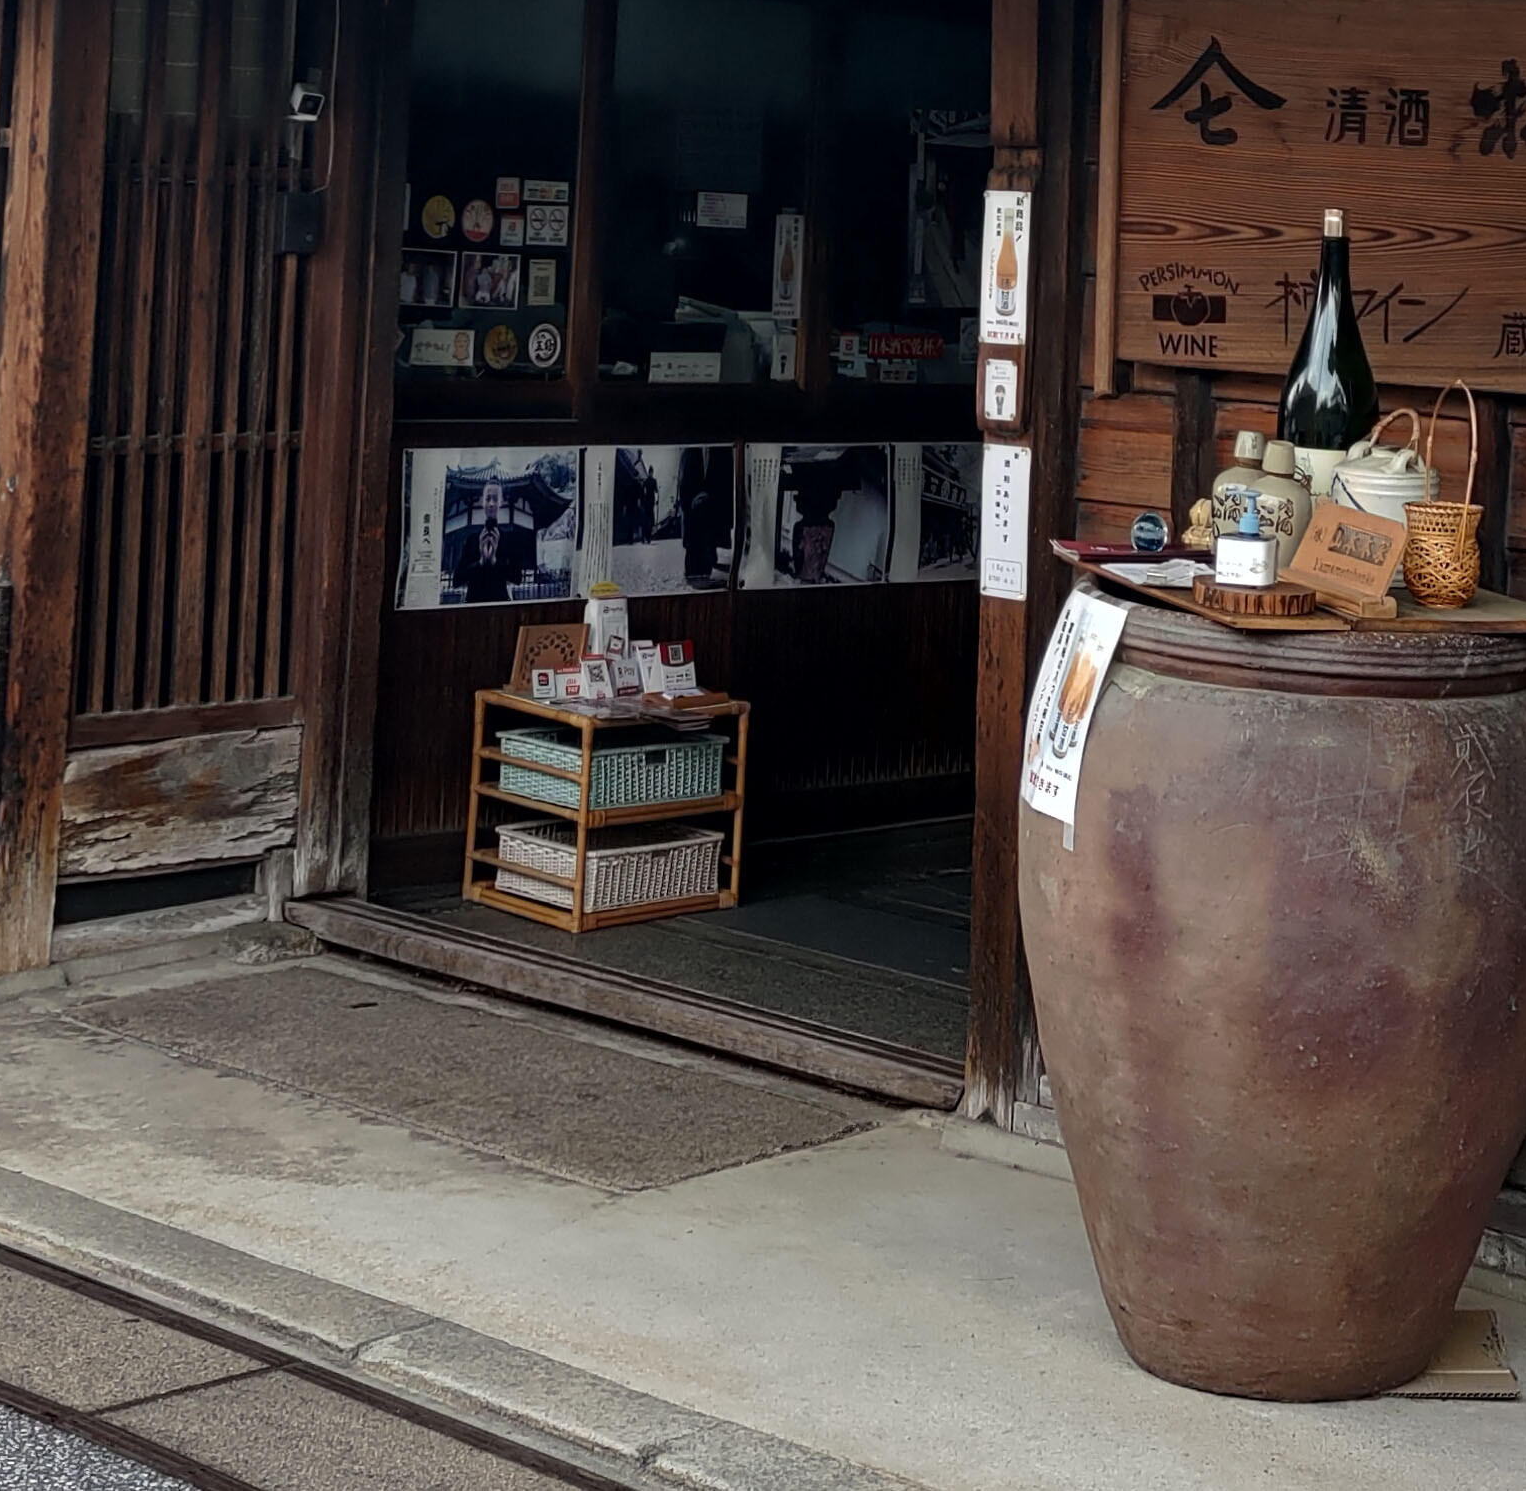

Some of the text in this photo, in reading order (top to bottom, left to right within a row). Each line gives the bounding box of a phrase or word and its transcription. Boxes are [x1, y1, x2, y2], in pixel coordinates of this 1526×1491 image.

[1324, 85, 1430, 147] 清酒
[1138, 262, 1240, 296] PERSIMMON
[1158, 332, 1218, 358] WINE
